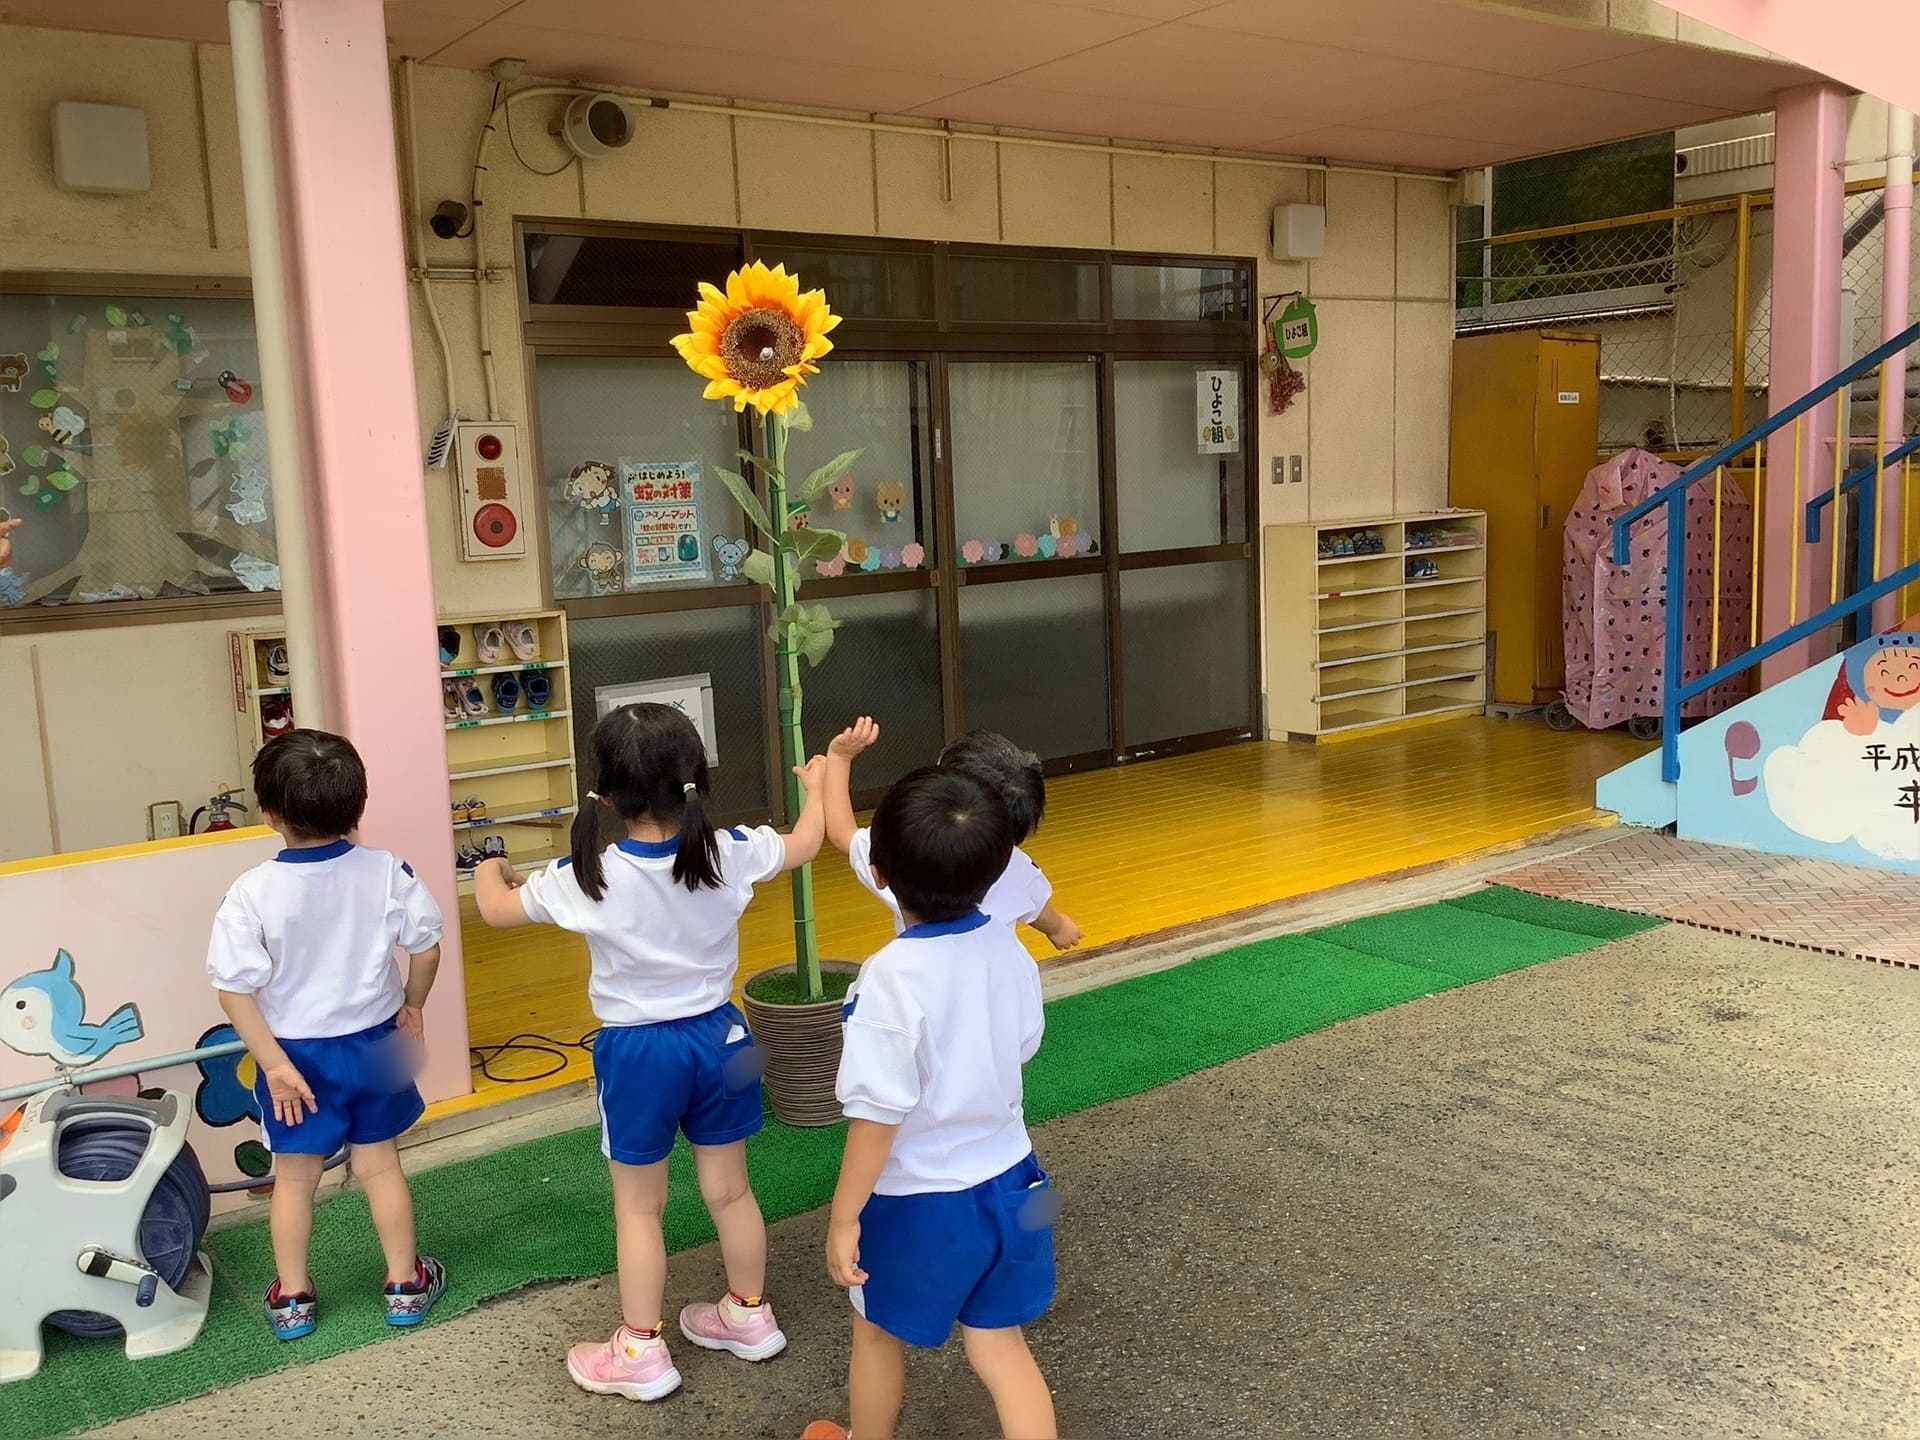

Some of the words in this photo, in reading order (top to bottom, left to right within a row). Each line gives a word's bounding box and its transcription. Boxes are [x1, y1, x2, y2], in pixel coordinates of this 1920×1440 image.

[1211, 376, 1224, 444] ひよこ組
[634, 481, 692, 500] 蚊の対策
